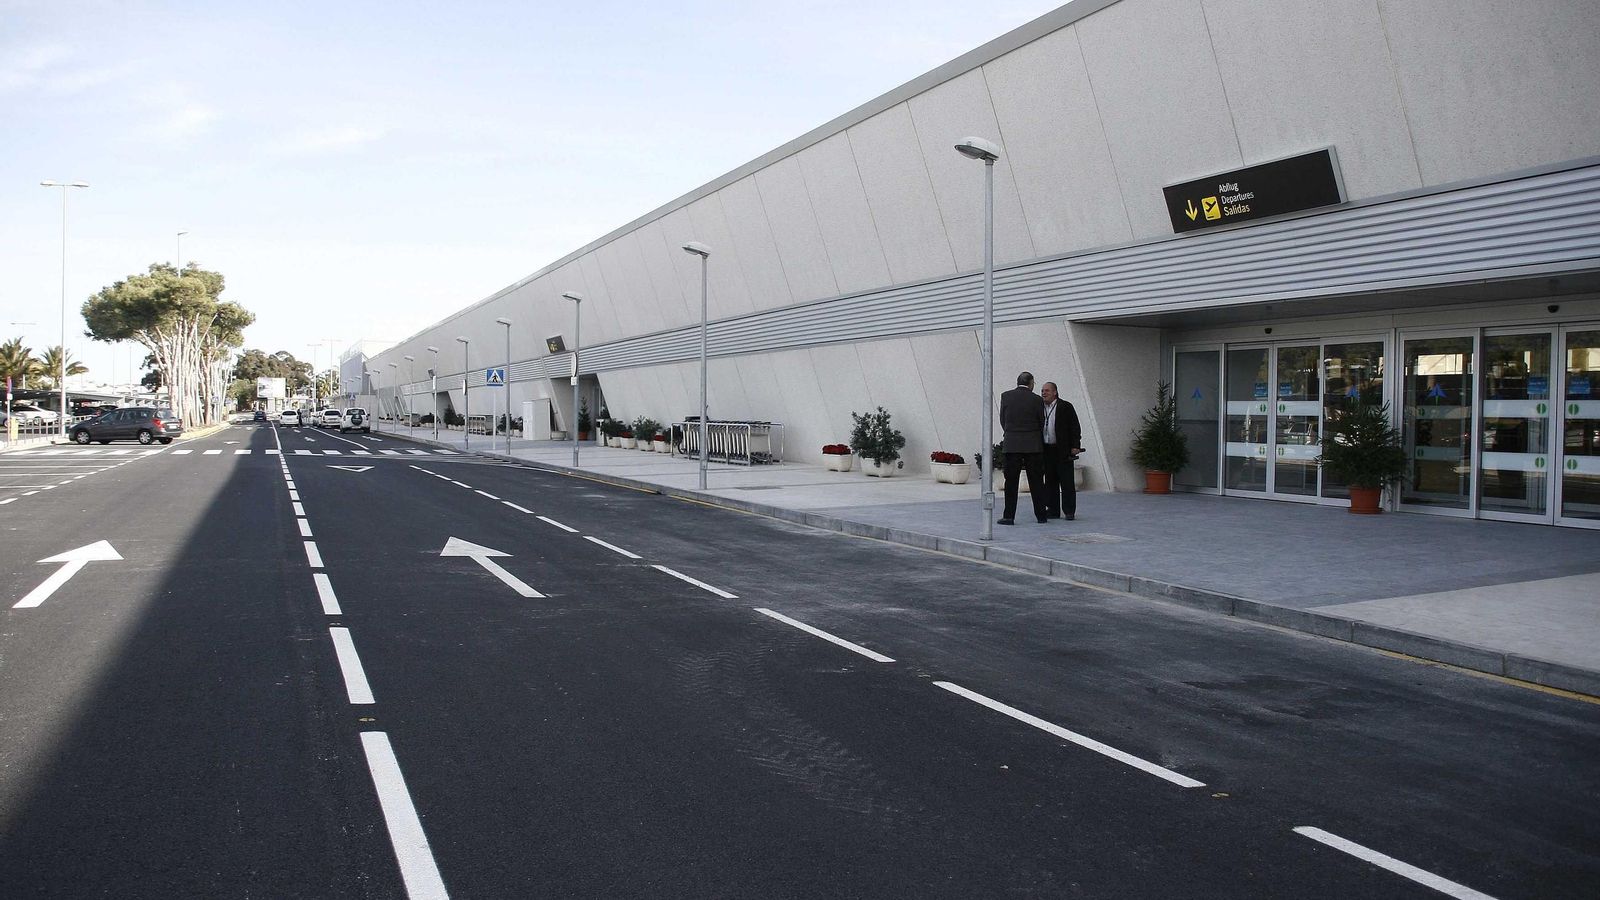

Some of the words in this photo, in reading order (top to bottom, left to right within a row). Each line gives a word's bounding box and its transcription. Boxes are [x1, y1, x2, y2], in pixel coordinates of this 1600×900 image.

[1219, 183, 1239, 193] Abflug
[1221, 192, 1254, 204] Departures
[1224, 204, 1250, 216] Salidas
